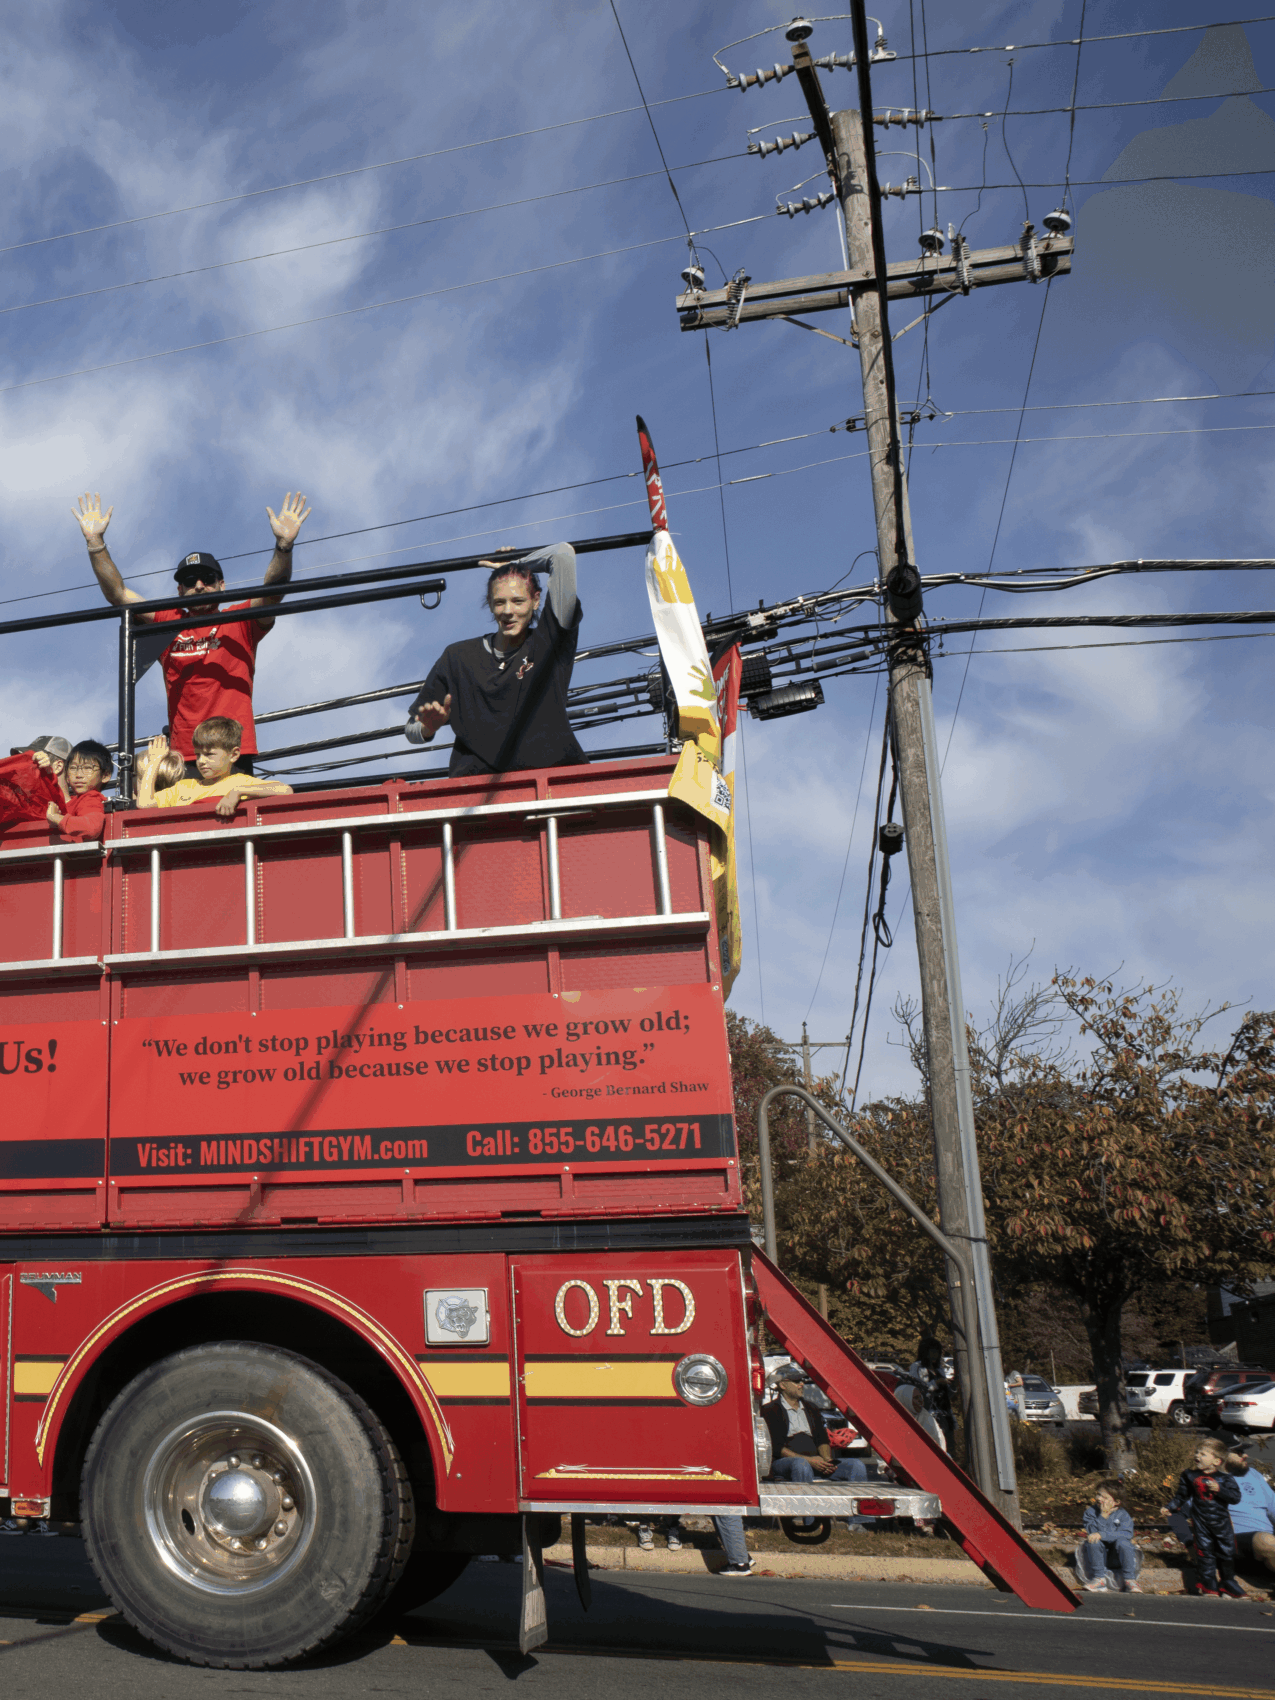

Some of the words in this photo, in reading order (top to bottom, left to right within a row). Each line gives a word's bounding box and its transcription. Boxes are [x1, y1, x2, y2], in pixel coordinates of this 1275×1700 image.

[142, 1038, 188, 1058] “We
[194, 1034, 252, 1056] don't
[258, 1035, 309, 1057] stop
[316, 1027, 408, 1052] playing
[413, 1023, 516, 1045] because
[522, 1022, 559, 1039] we
[565, 1018, 631, 1041] grow
[639, 1009, 691, 1035] old;
[178, 1071, 211, 1086] we
[216, 1068, 277, 1090] grow
[283, 1060, 322, 1083] old
[328, 1057, 429, 1081] because
[434, 1058, 471, 1075] we
[476, 1053, 532, 1077] stop
[538, 1042, 656, 1073] playing.”
[550, 1087, 603, 1100] George
[606, 1081, 667, 1097] Bernard
[670, 1080, 710, 1093] Shaw
[137, 1142, 193, 1168] Visit:
[200, 1133, 428, 1166] MINDSHIFTGYM.com
[466, 1130, 520, 1158] Call:
[527, 1121, 703, 1155] 855-646-5271
[554, 1278, 696, 1338] OFD
